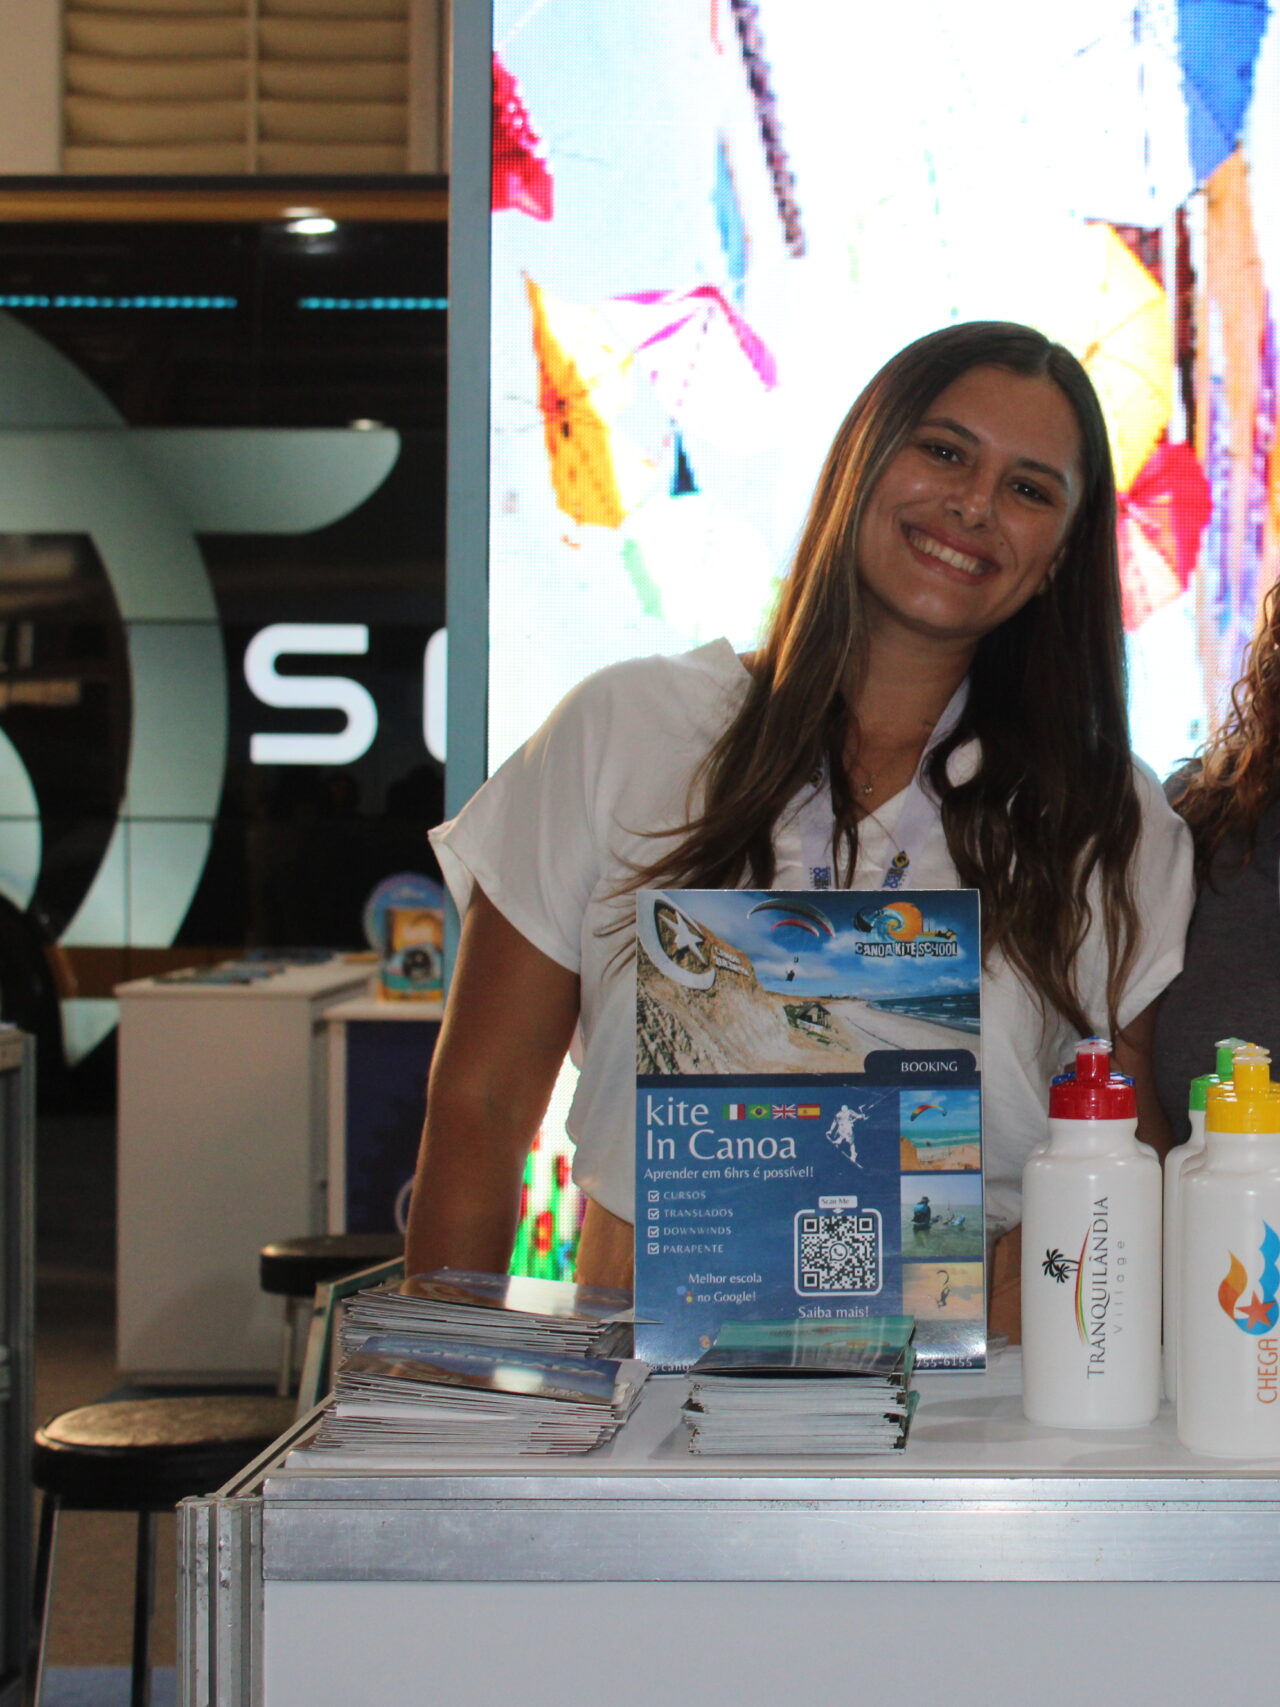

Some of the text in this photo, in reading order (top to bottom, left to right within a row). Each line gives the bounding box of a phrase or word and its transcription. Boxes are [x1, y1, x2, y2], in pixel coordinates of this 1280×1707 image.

[856, 942, 893, 957] CANOA
[918, 942, 958, 956] SCHOOL
[901, 1062, 958, 1073] BOOKING
[646, 1095, 710, 1126] kite
[646, 1129, 798, 1160] In Canoa
[644, 1166, 815, 1182] Aprender em 6hrs é possível!
[663, 1191, 707, 1200] CURSOS
[663, 1209, 735, 1218] TRANSLADOS
[663, 1226, 733, 1236] DOWNWINDS
[663, 1244, 725, 1254] PARAPENTE
[688, 1272, 763, 1284] Melhor escola
[1087, 1196, 1110, 1379] TRANQUILÂNDIA
[1112, 1239, 1126, 1334] Village
[697, 1291, 757, 1304] no Google!
[798, 1305, 870, 1319] Saiba mais!
[915, 1358, 973, 1369] 755-6155
[1257, 1338, 1279, 1404] CHEGA
